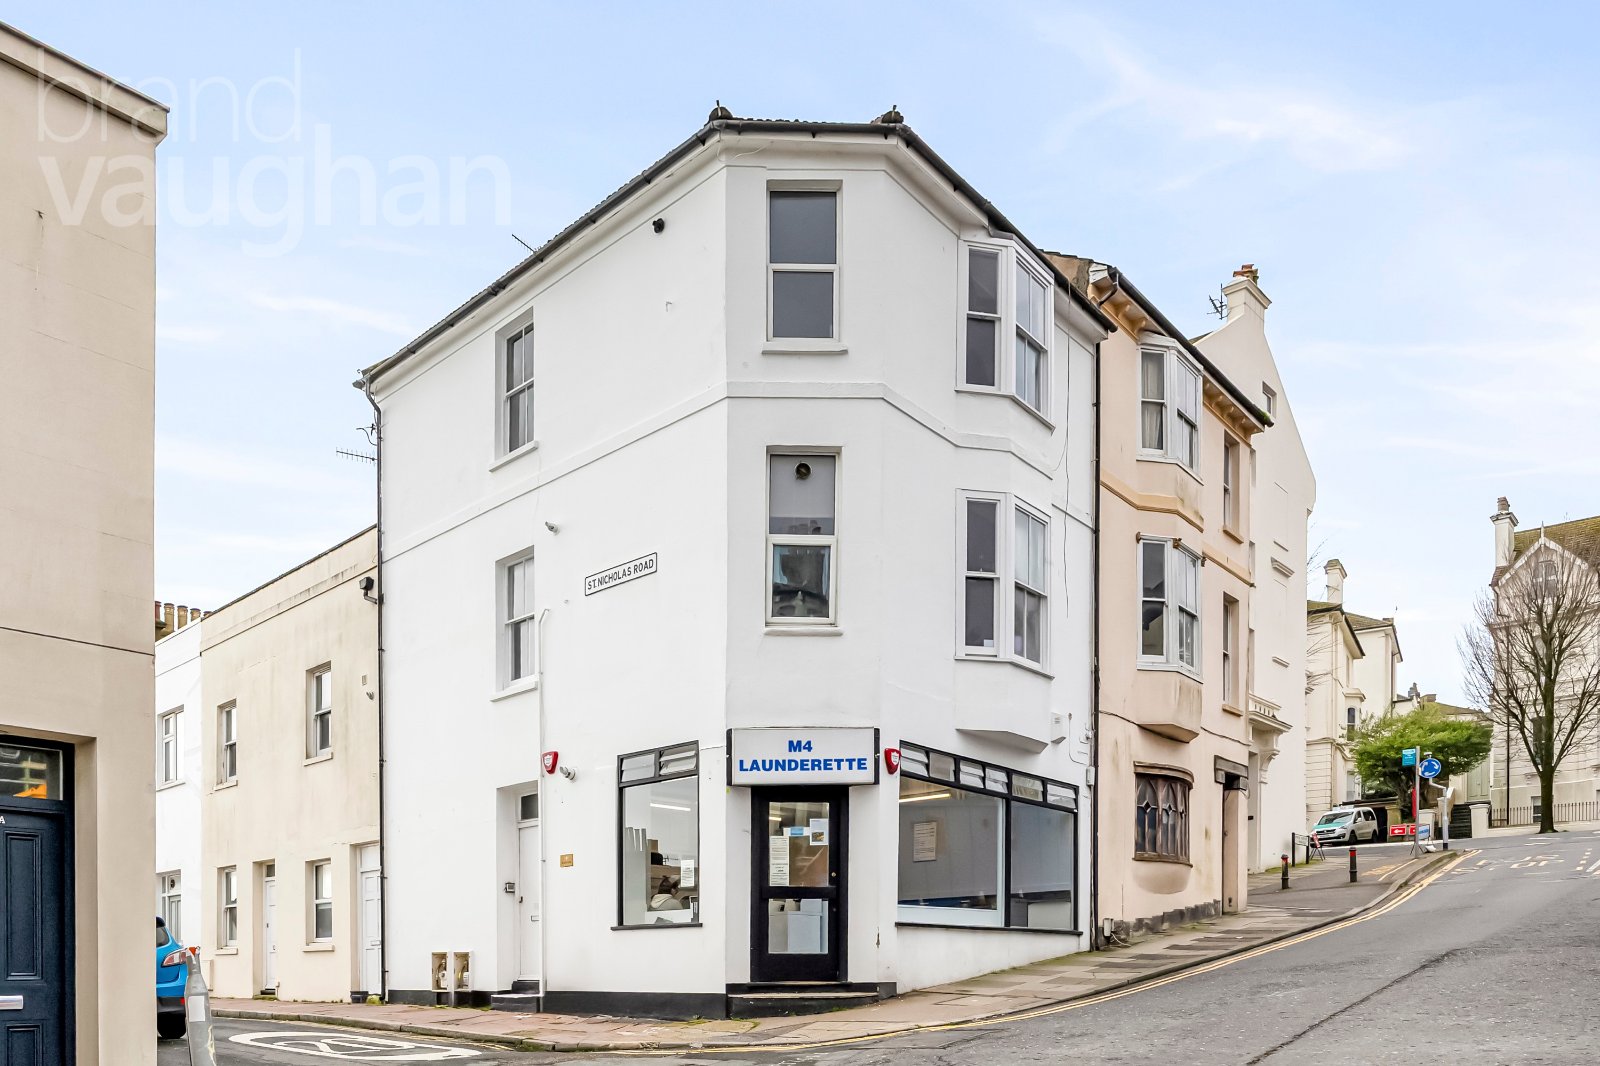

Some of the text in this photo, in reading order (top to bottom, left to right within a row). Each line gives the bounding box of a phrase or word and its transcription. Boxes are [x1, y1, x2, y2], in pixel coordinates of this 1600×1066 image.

[597, 566, 632, 587] NICHOLAS
[633, 558, 654, 574] ROAD
[788, 740, 813, 753] M4
[739, 758, 868, 772] LAUNDERETTE
